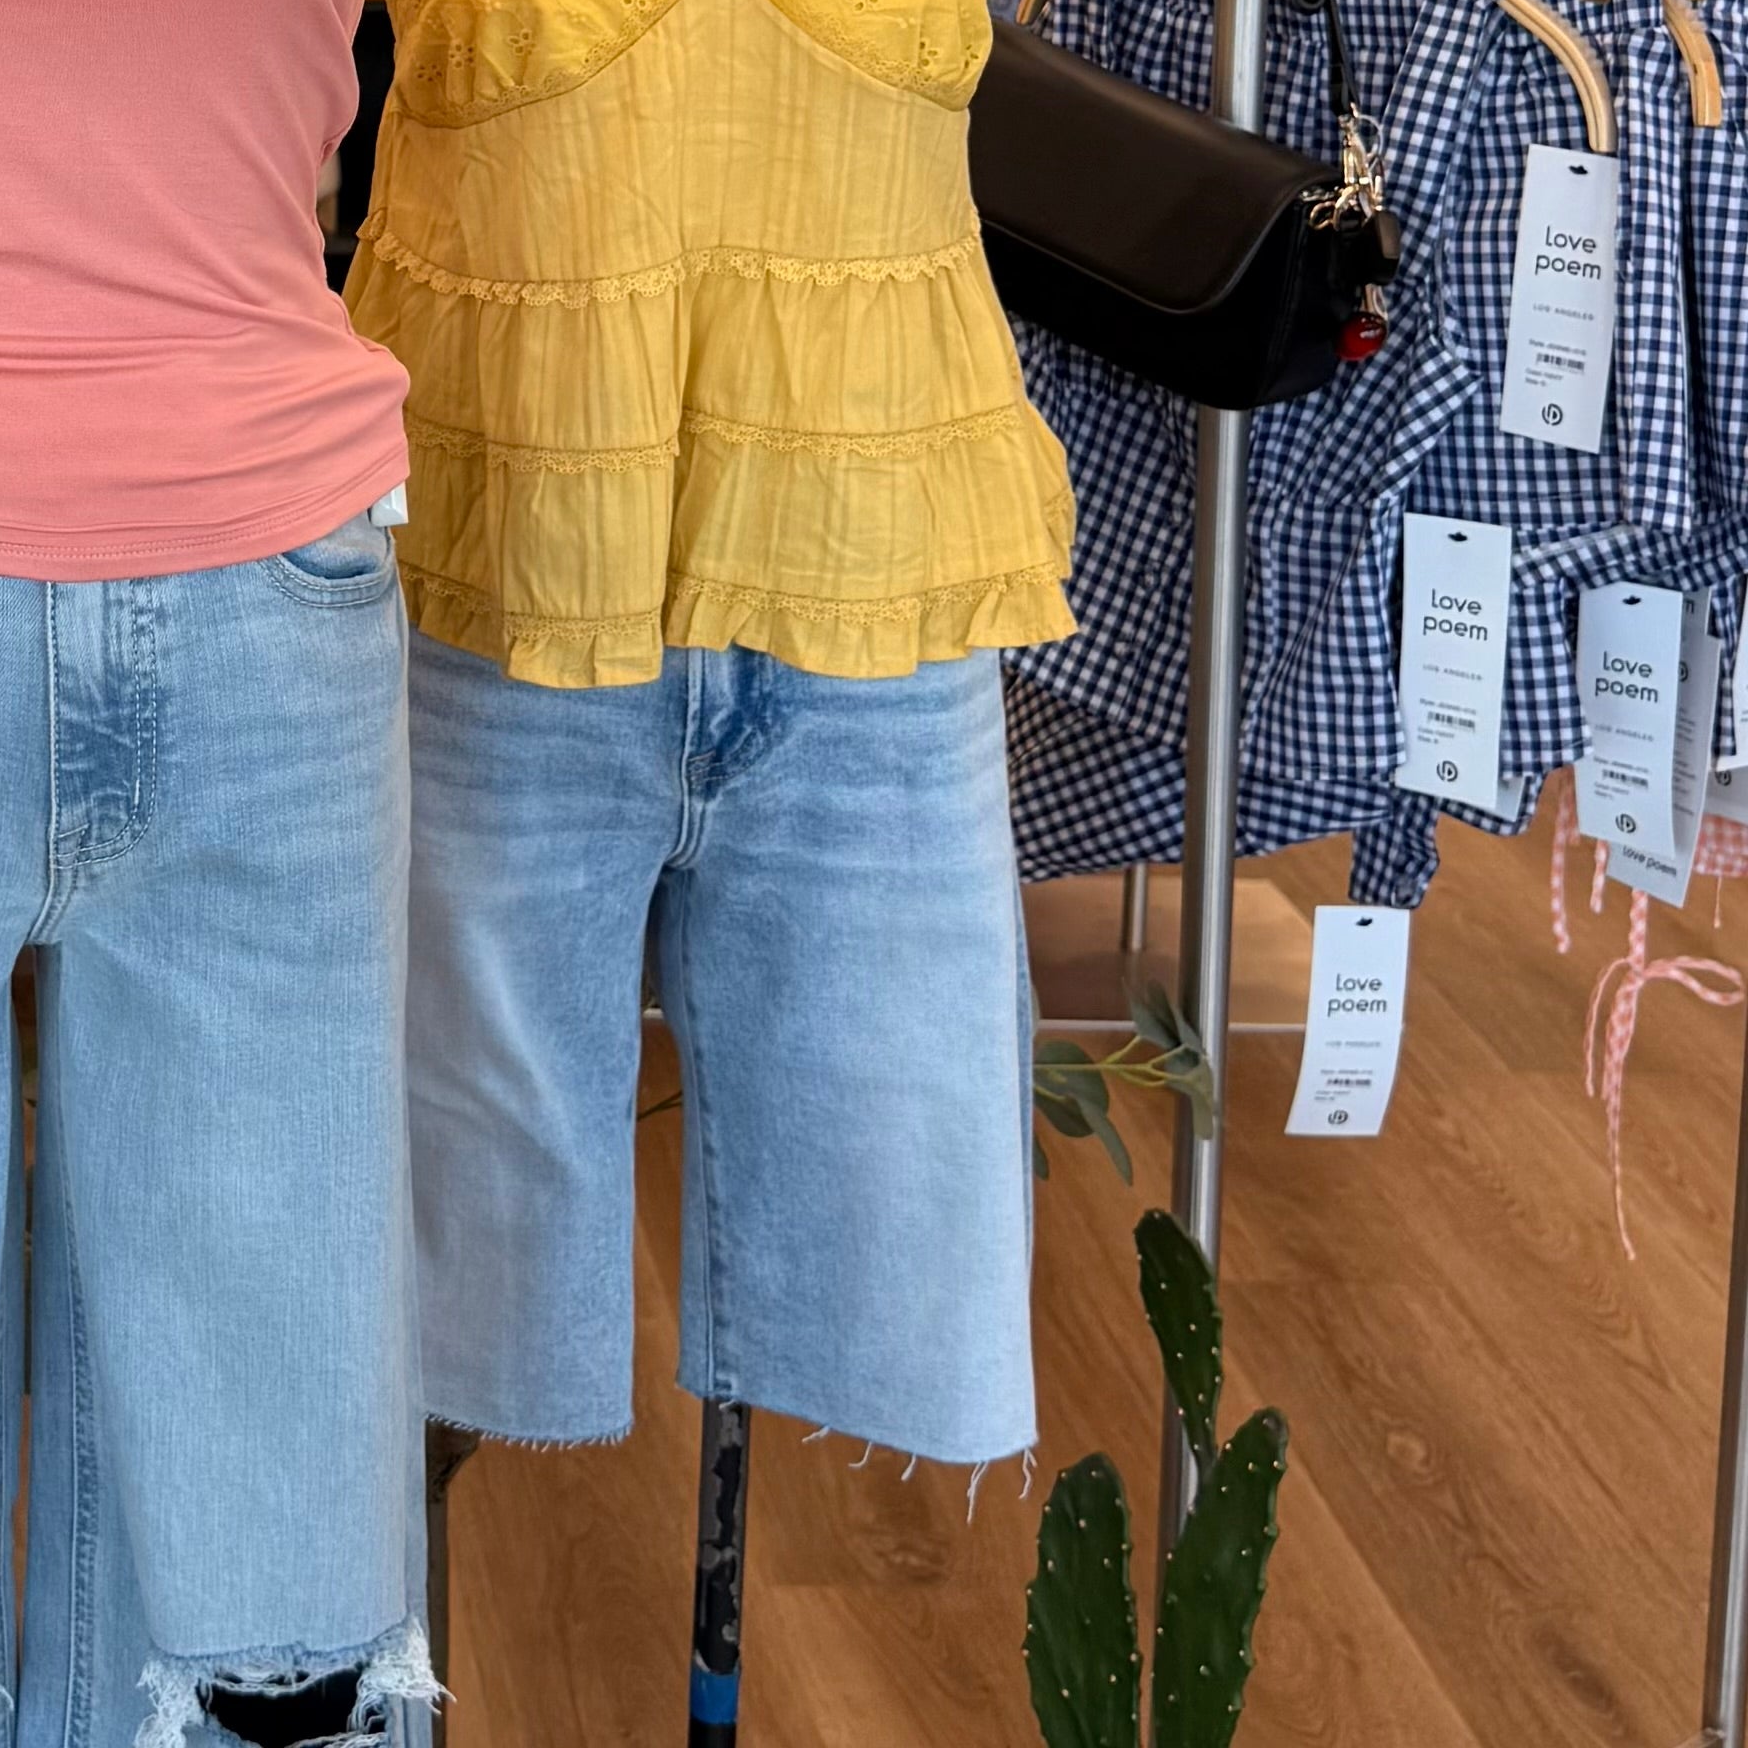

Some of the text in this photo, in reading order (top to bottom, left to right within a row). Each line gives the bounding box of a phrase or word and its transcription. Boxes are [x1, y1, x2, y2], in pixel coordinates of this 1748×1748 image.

[1534, 254, 1602, 281] poem
[1423, 615, 1488, 641] poem
[1594, 677, 1659, 703] poem
[1646, 855, 1678, 878] poem
[1327, 997, 1388, 1019] poem
